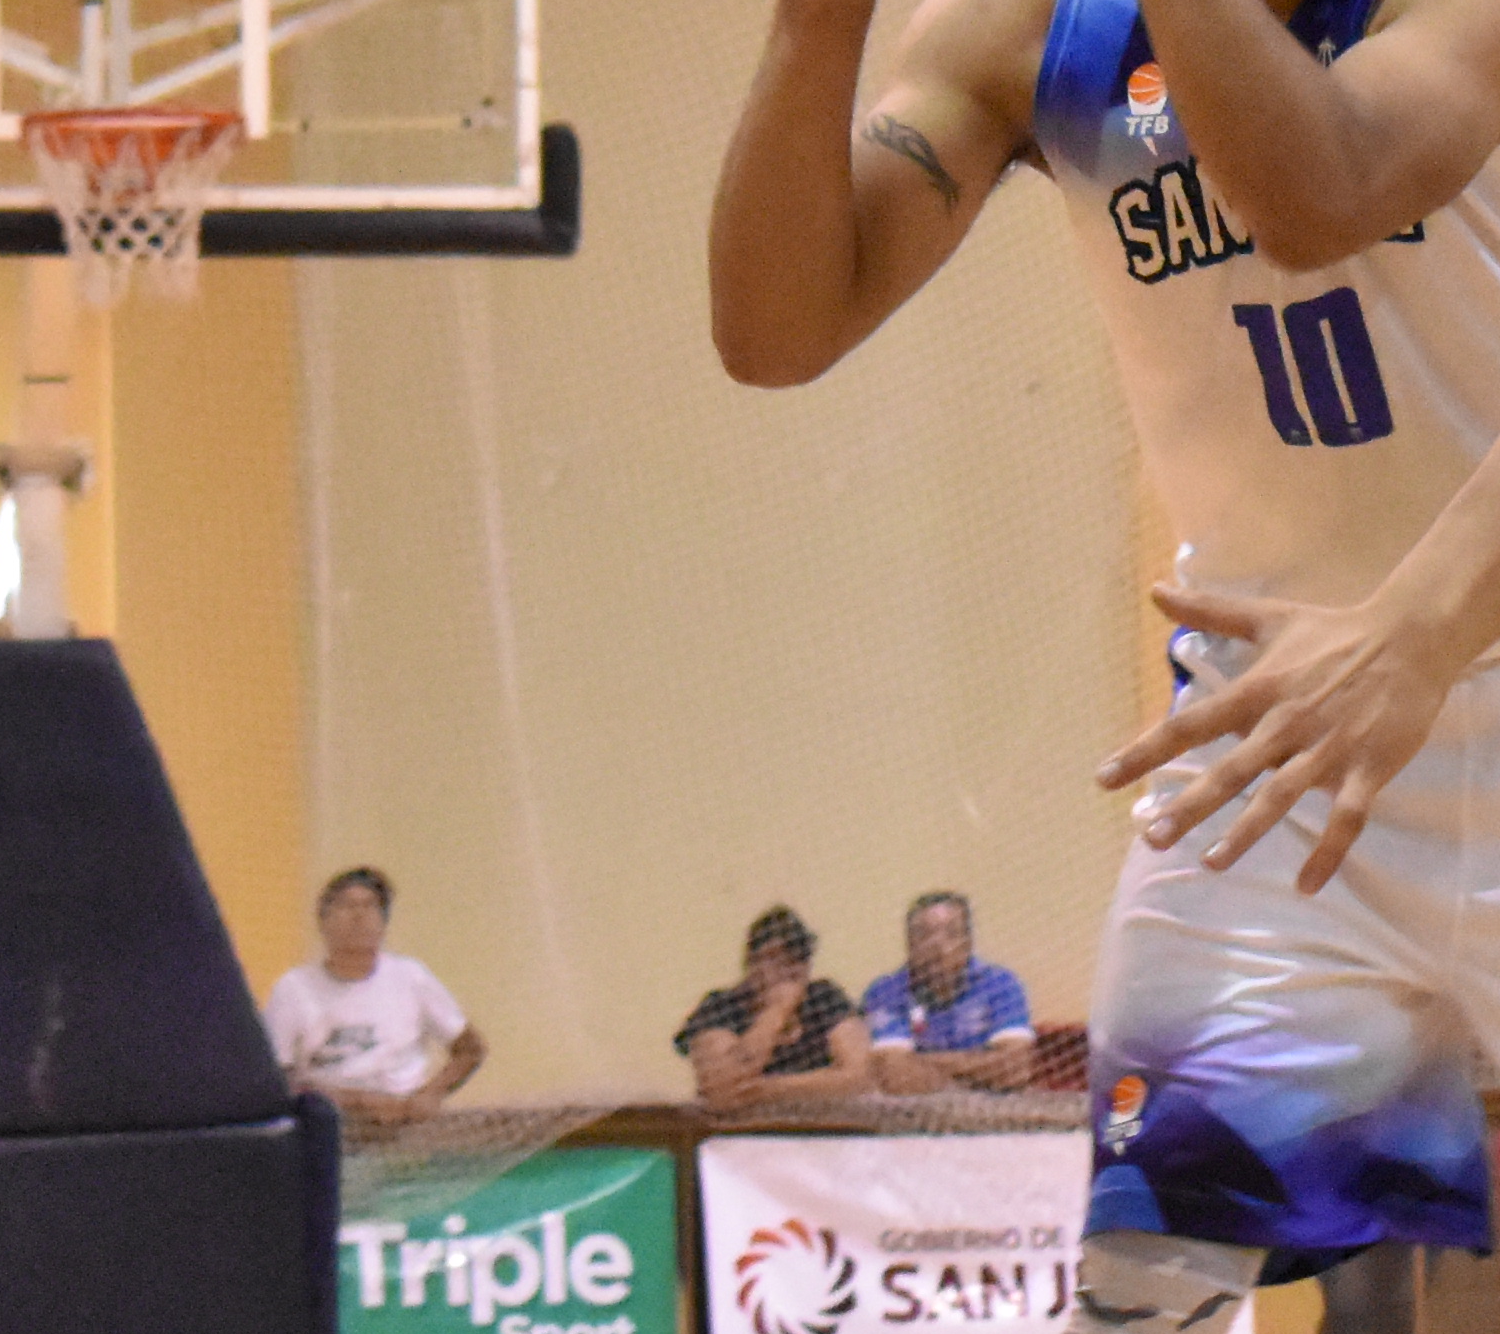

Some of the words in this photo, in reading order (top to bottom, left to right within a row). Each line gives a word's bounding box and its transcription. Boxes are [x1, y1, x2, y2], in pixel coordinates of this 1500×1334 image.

[1125, 114, 1170, 136] TFB
[1232, 286, 1394, 449] 10
[338, 1212, 635, 1326] Triple
[881, 1261, 1028, 1324] SAN
